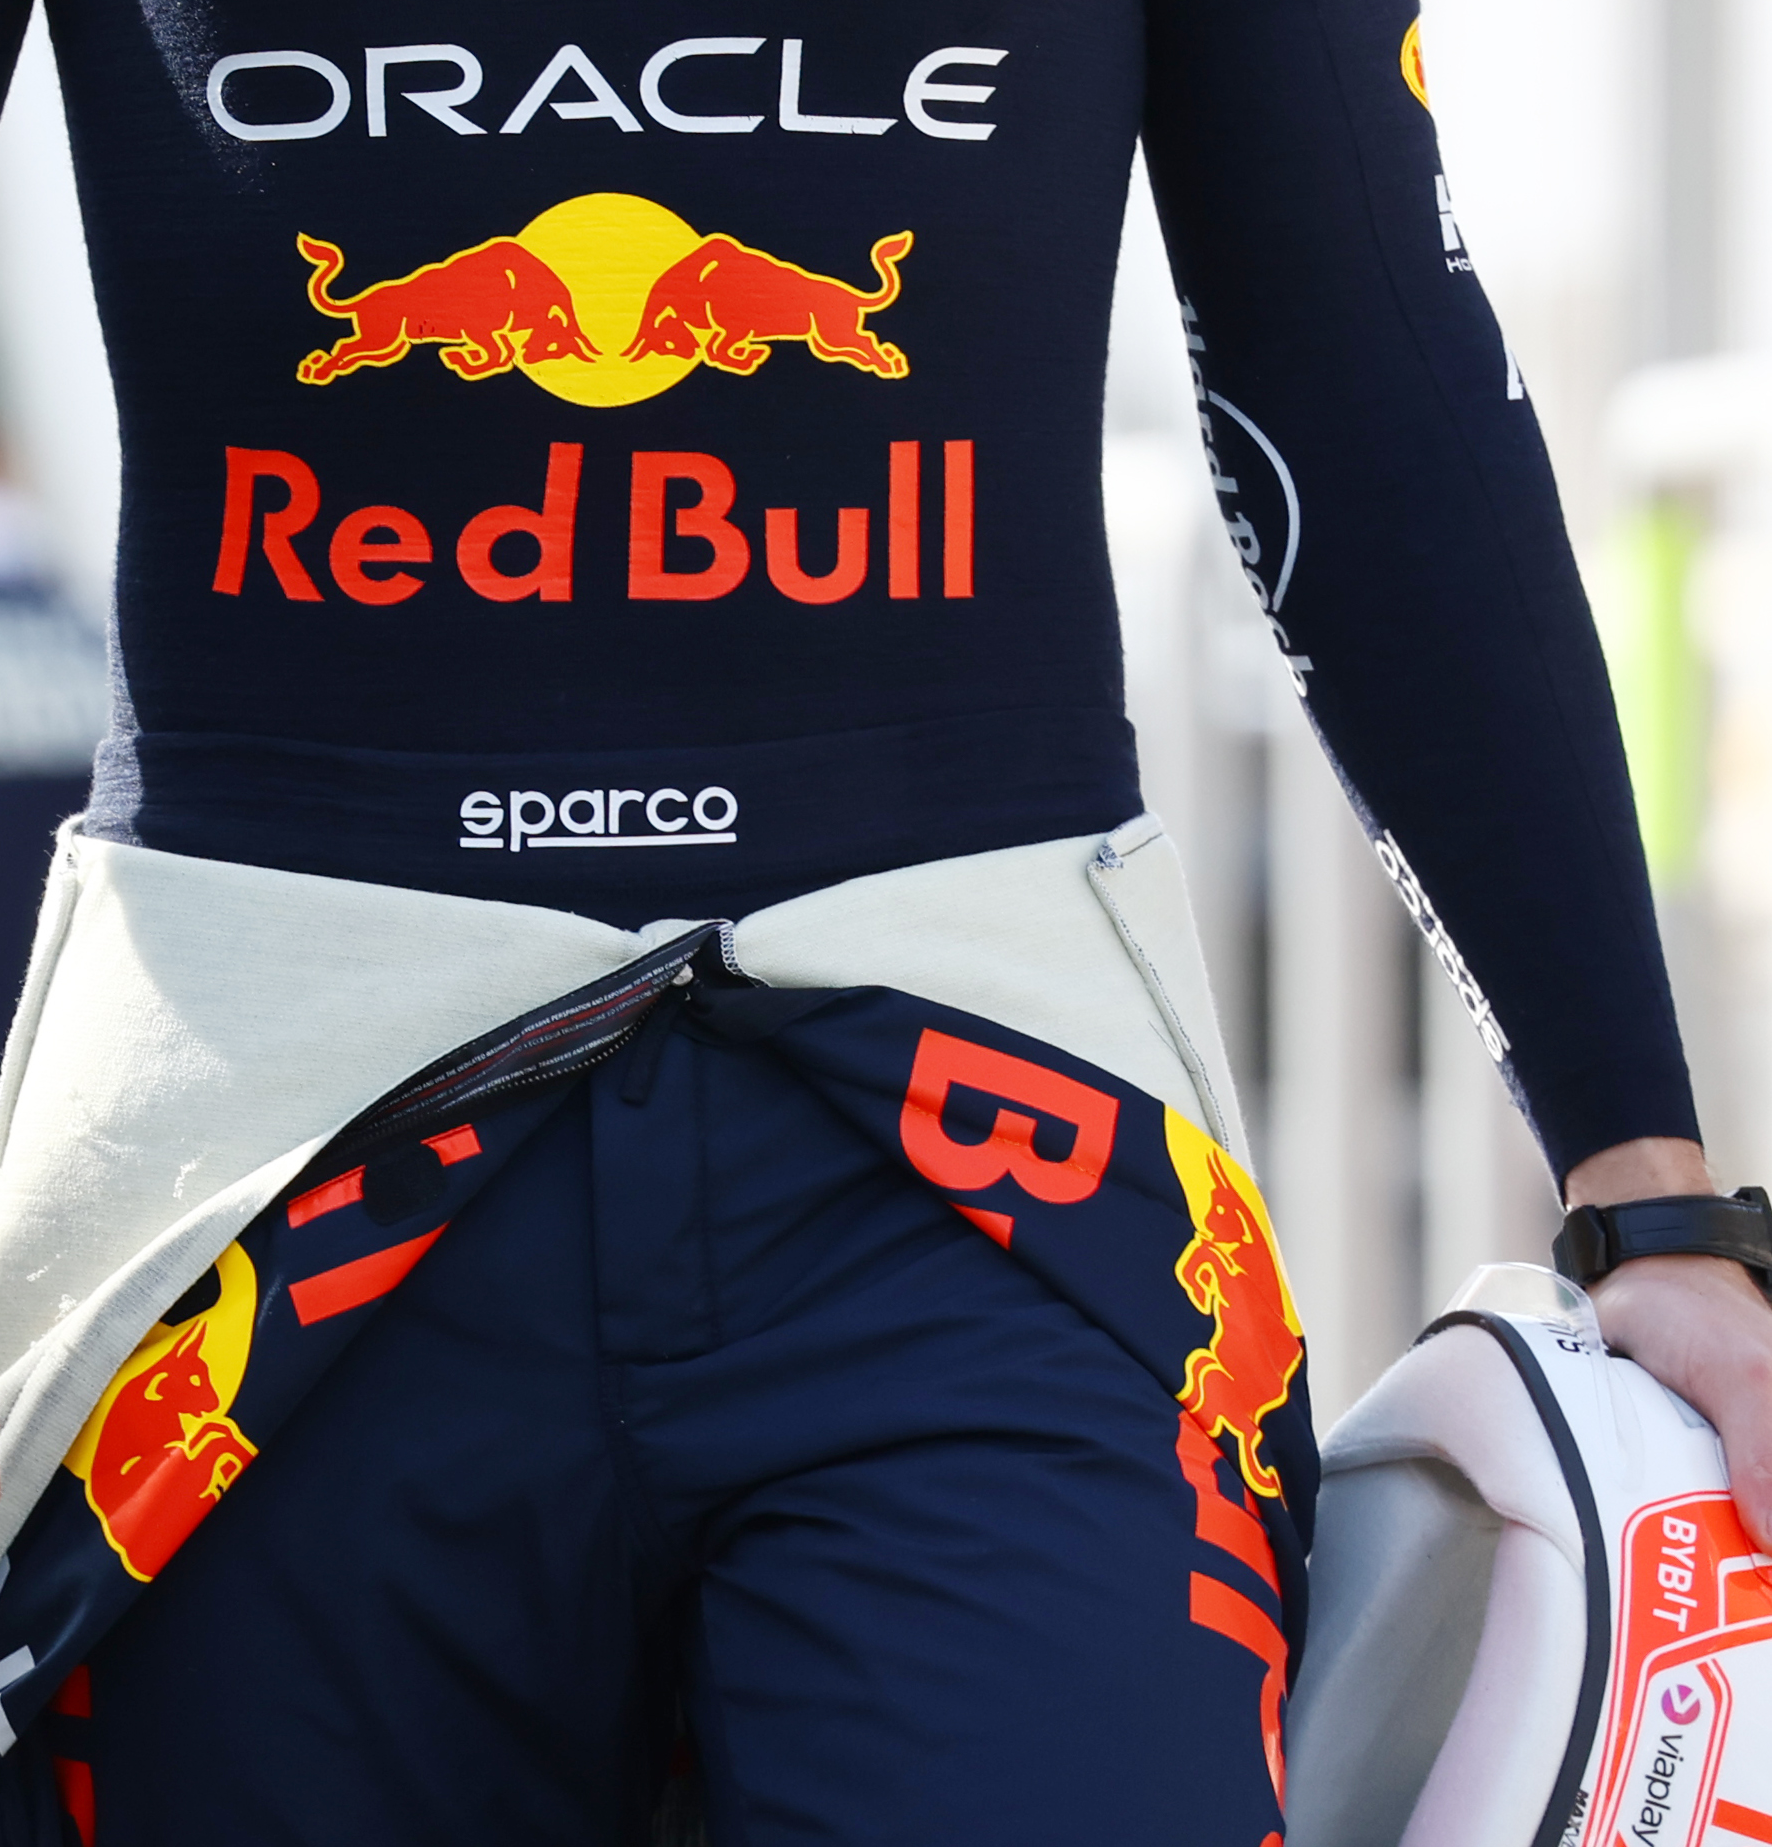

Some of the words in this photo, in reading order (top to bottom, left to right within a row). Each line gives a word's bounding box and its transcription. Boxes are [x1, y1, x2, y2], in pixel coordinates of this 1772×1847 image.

[207, 36, 1010, 142] ORACLE
[212, 442, 584, 606] Red
[627, 439, 974, 605] Bull
[460, 785, 738, 852] sparco
[1652, 1515, 1697, 1633] BYBIT
[1632, 1735, 1684, 1847] viaplay
